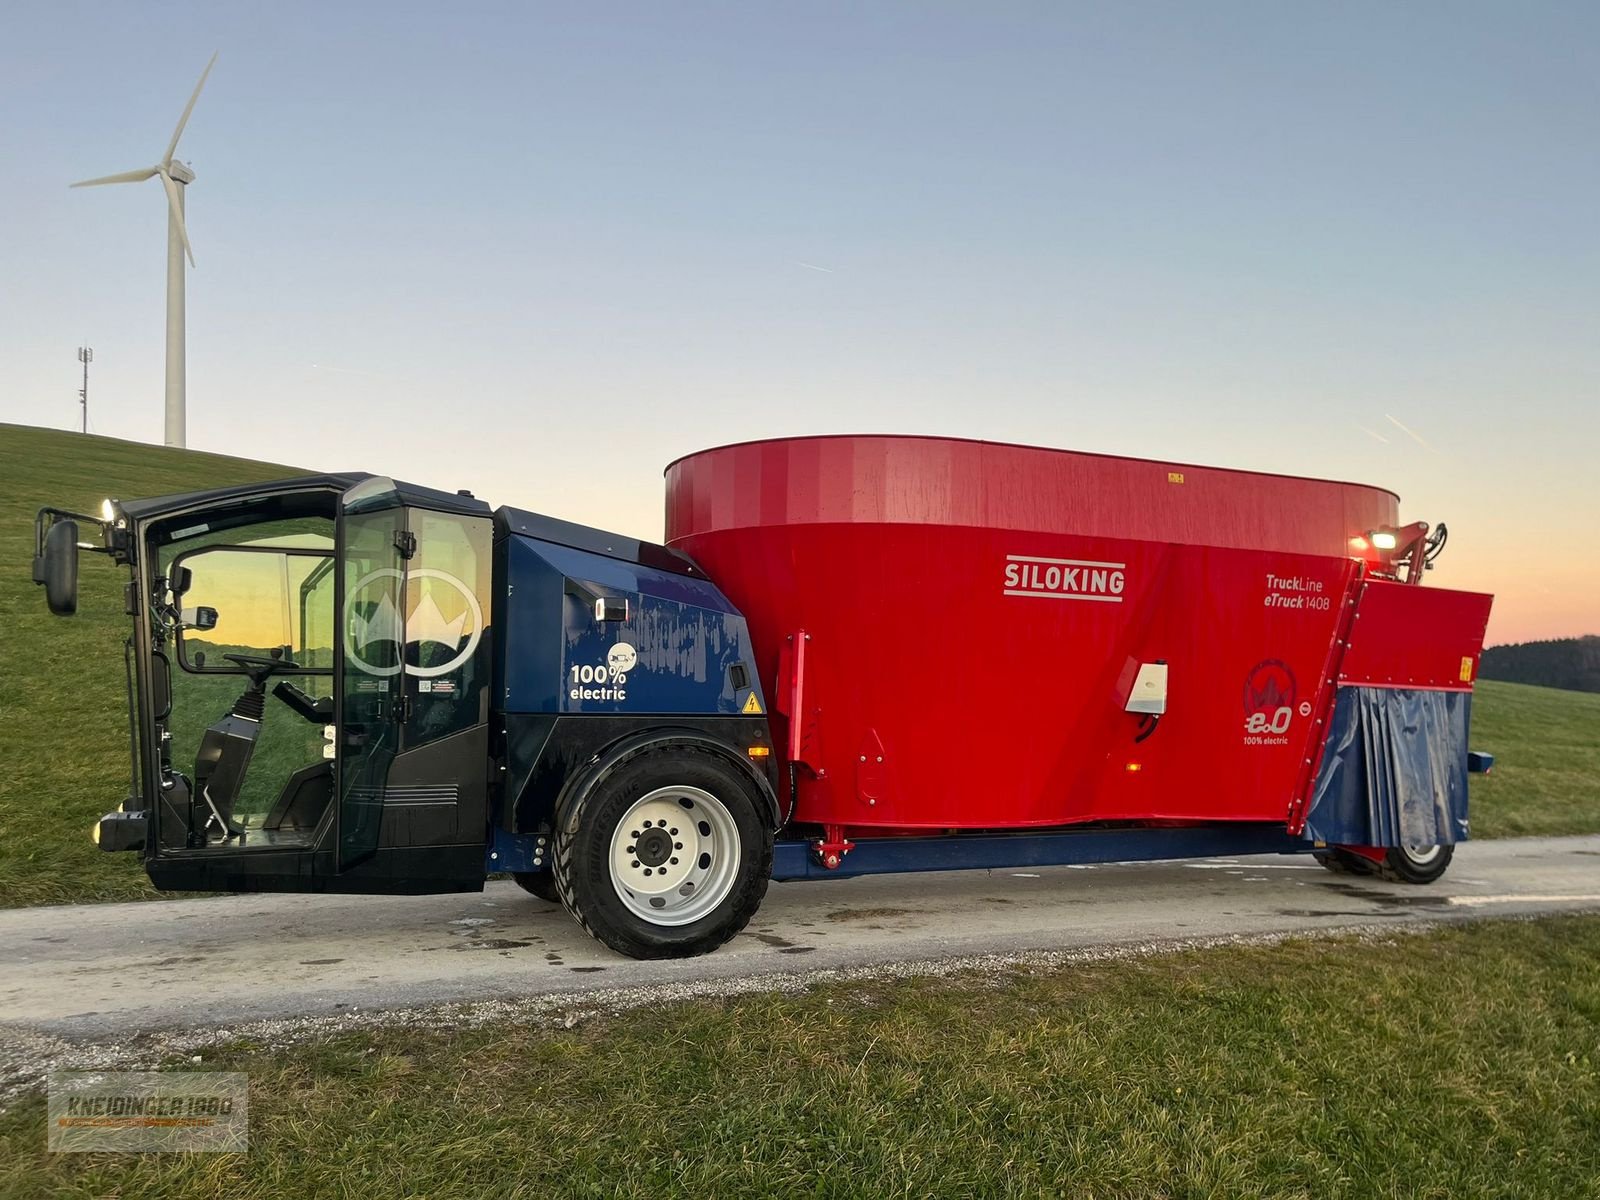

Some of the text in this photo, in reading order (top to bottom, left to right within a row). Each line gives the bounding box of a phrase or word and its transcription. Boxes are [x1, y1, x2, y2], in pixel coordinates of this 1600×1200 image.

[1004, 563, 1125, 594] SILOKING
[1266, 574, 1323, 592] TruckLine
[1264, 593, 1330, 610] eTruck 1408
[570, 664, 627, 684] 100%
[570, 686, 626, 700] electric
[1243, 736, 1288, 745] 100% electric
